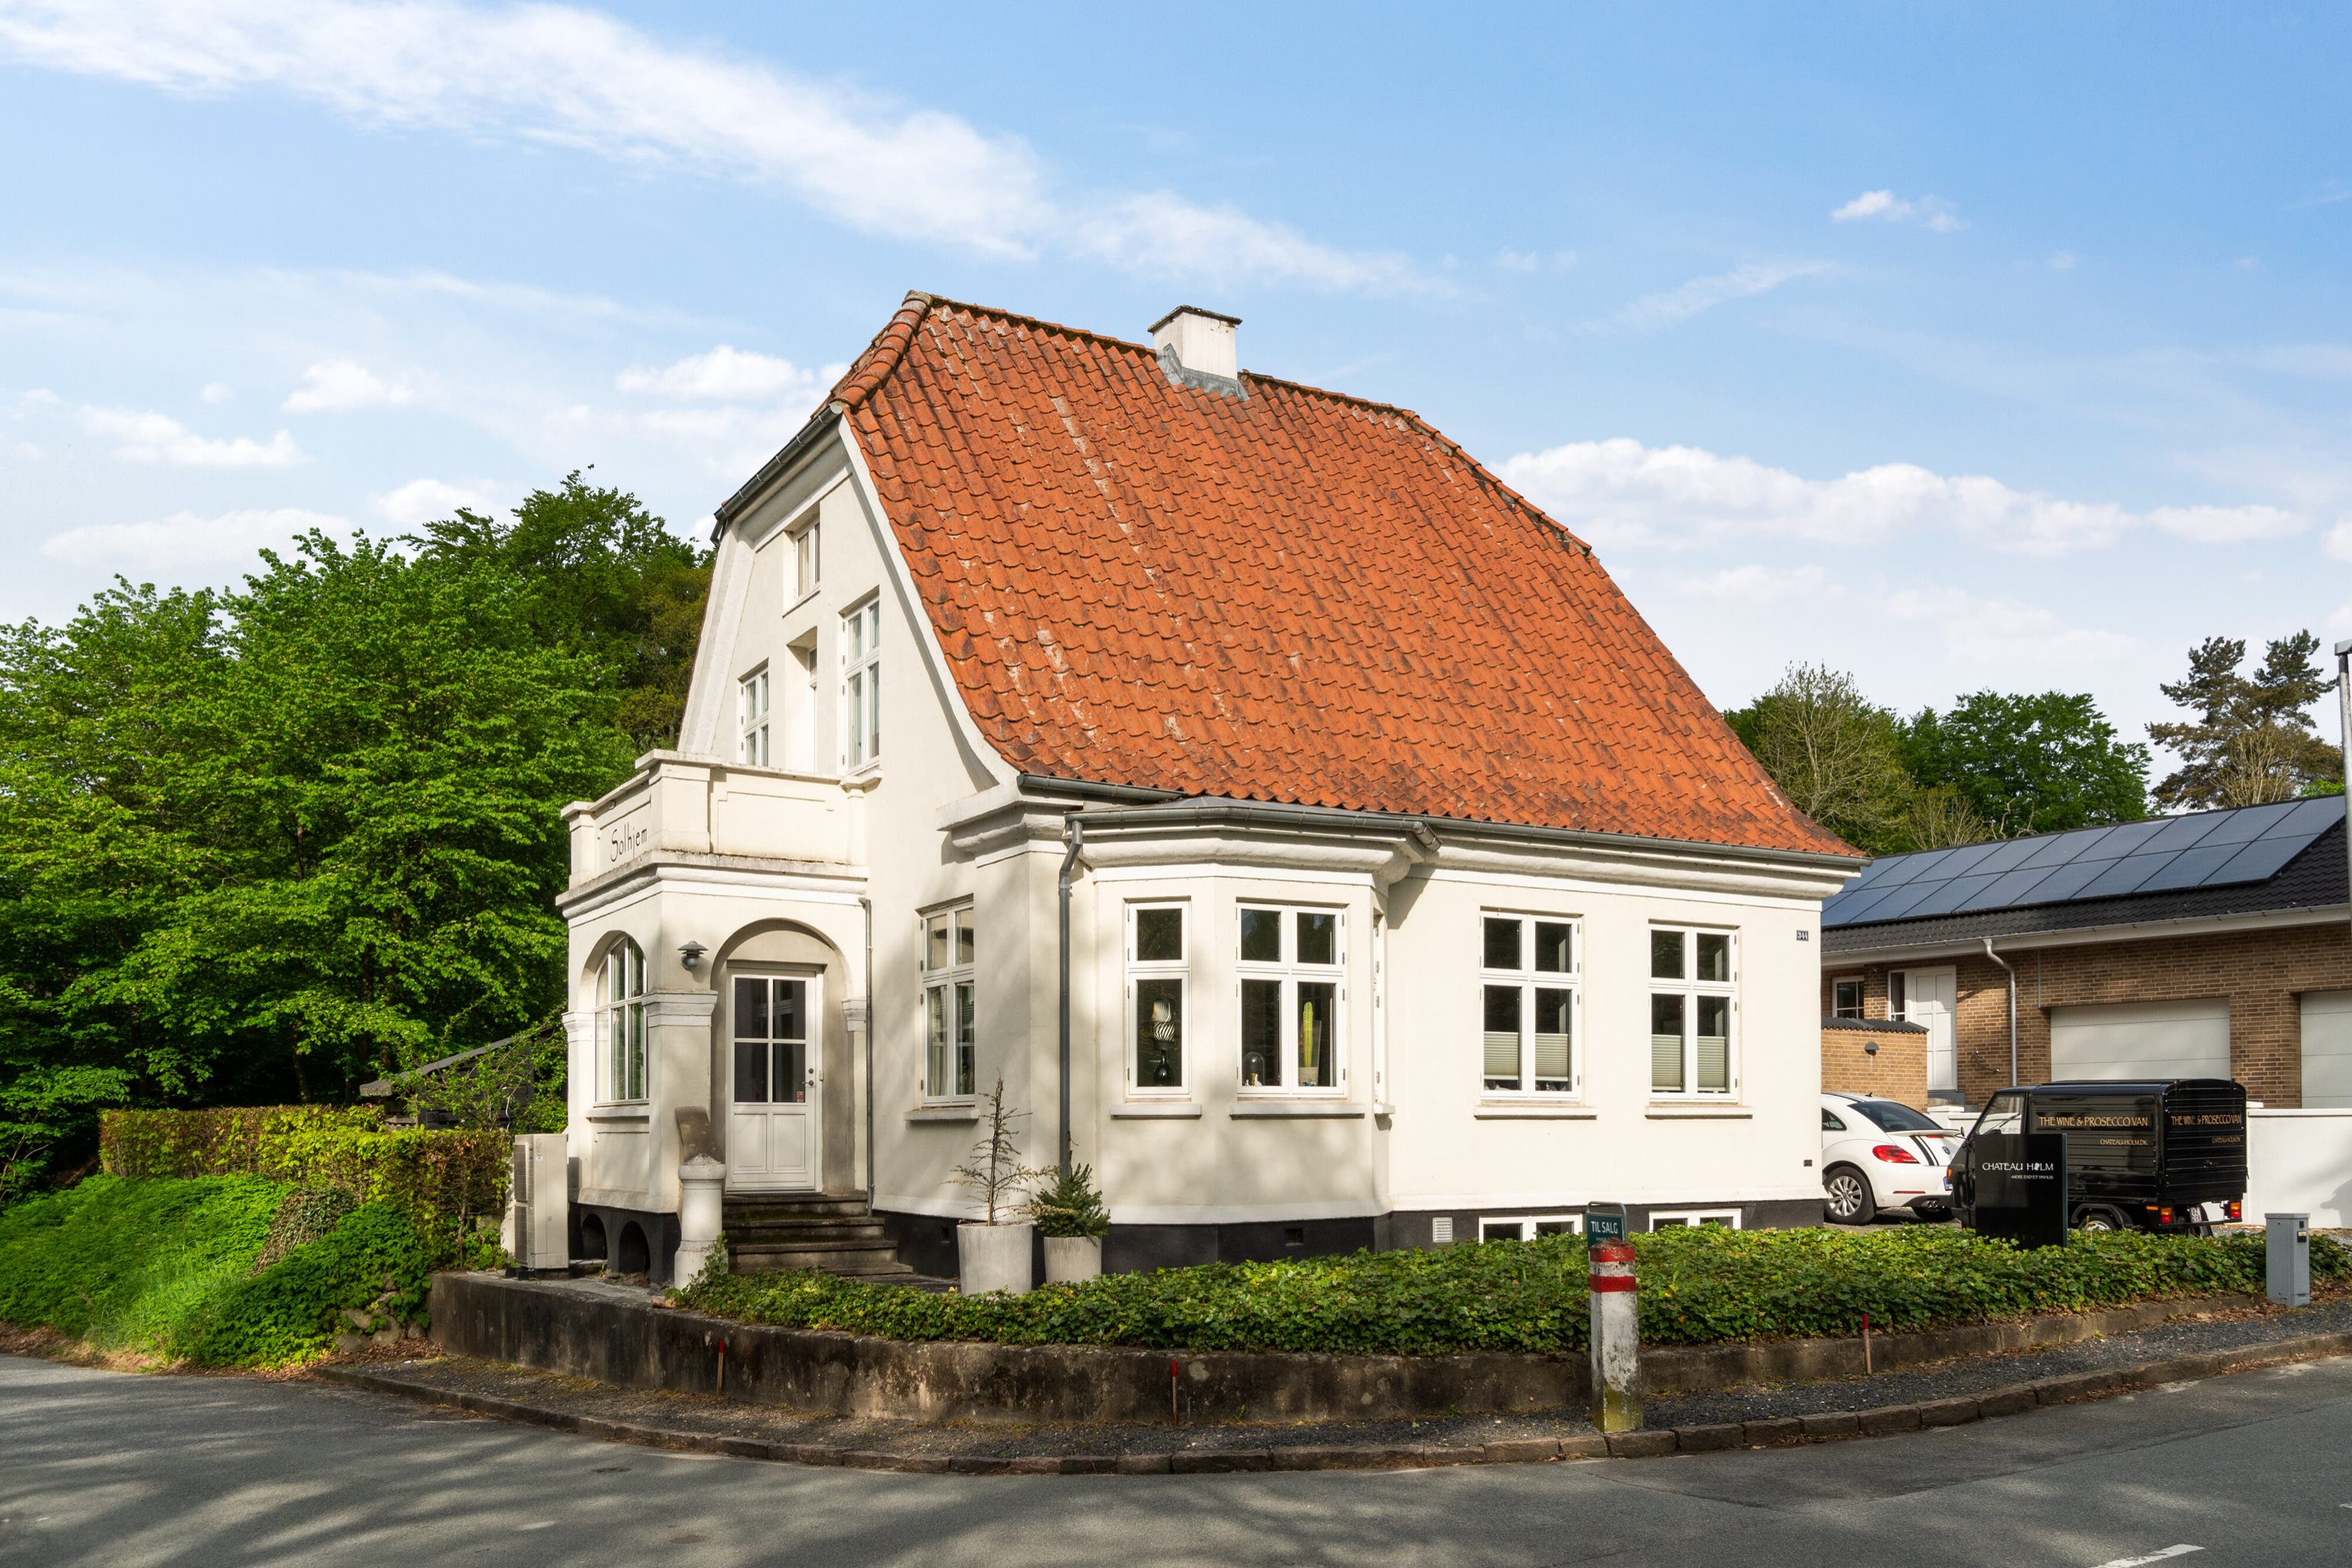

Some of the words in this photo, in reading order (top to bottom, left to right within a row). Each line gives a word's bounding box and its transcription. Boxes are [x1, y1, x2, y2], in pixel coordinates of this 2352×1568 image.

[610, 822, 648, 862] Solhjem
[2038, 1116, 2056, 1127] THE
[2056, 1116, 2076, 1127] WINE
[2076, 1116, 2083, 1127] &
[2084, 1116, 2131, 1127] PROSECCO
[2131, 1116, 2148, 1127] VAN
[2171, 1116, 2183, 1126] THE
[2183, 1116, 2196, 1125] WINE
[2201, 1114, 2231, 1124] PROSECCO
[2231, 1114, 2241, 1123] VAN
[1982, 1162, 2023, 1171] CHATEAU
[1591, 1221, 1601, 1232] TIL
[1602, 1221, 1618, 1234] SALG
